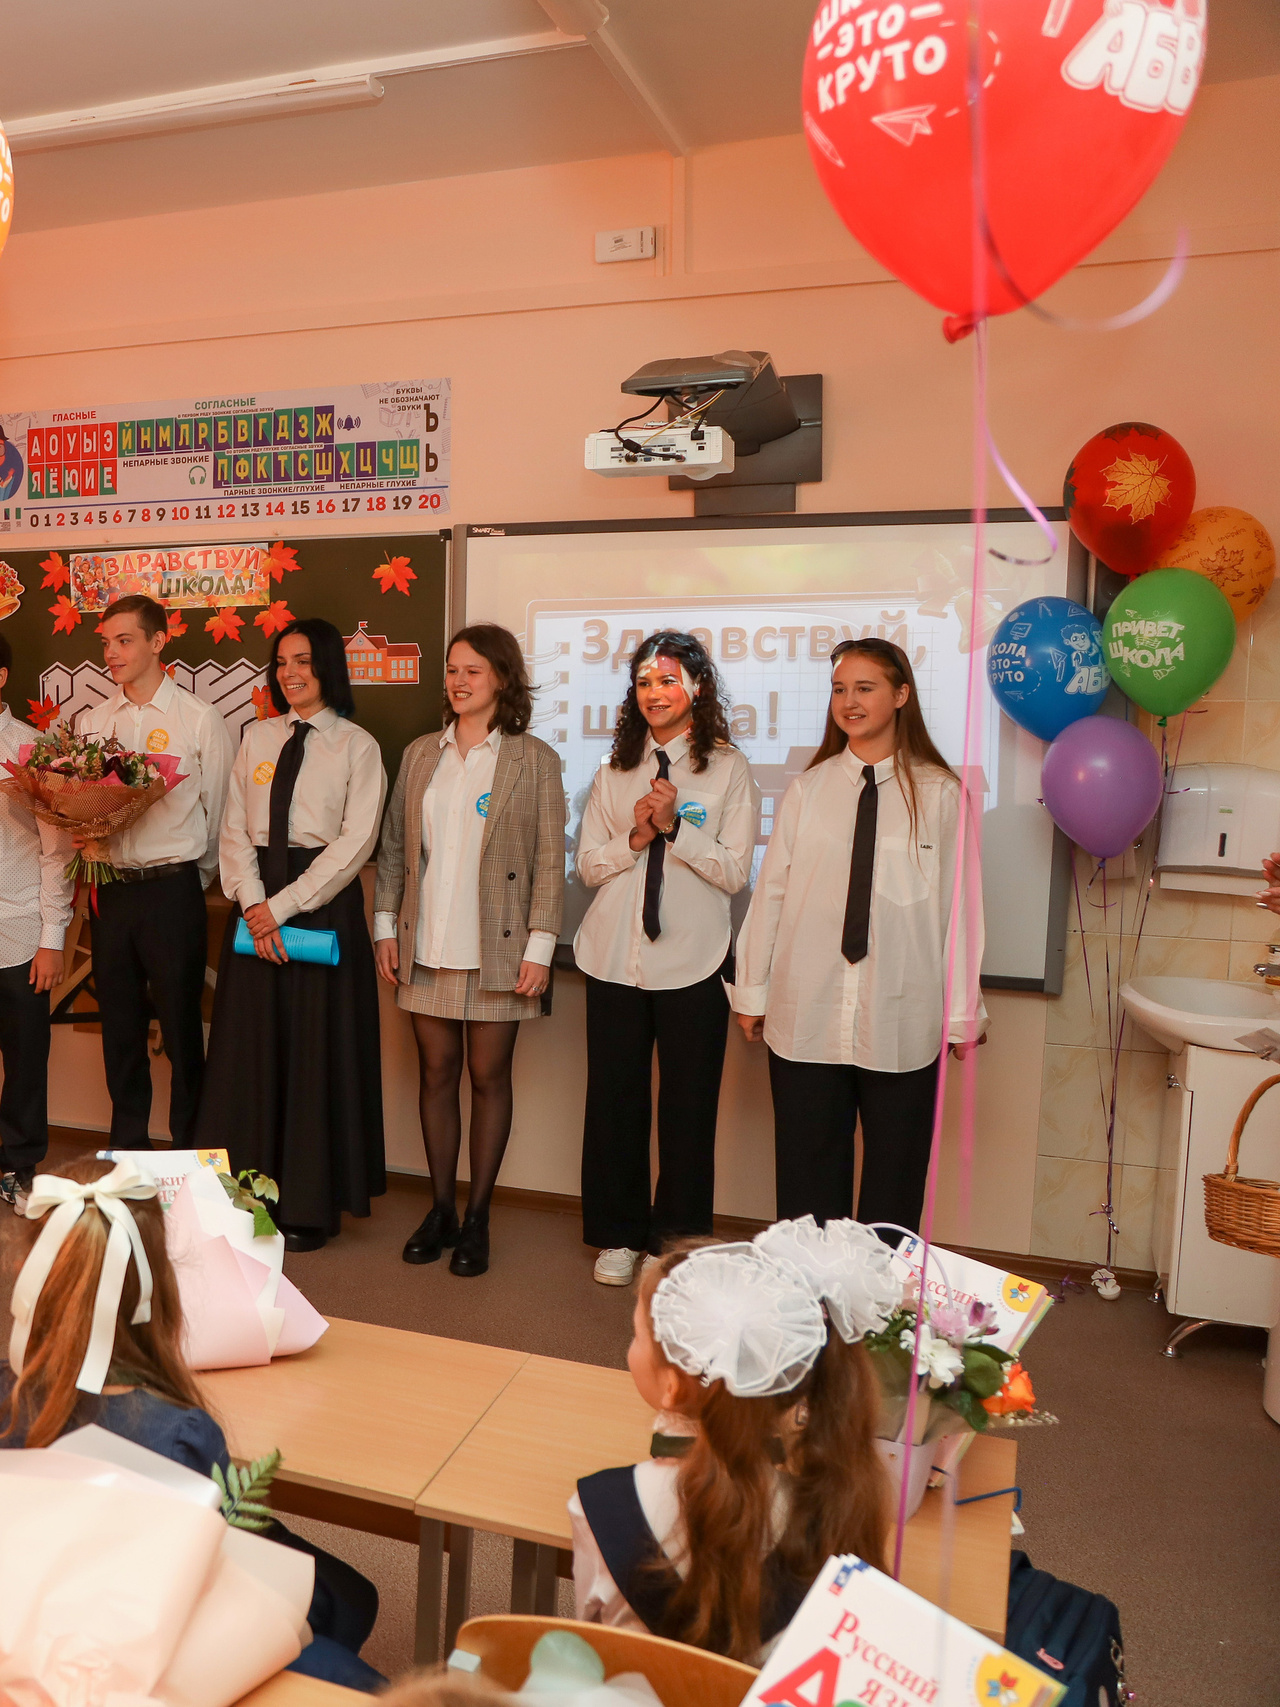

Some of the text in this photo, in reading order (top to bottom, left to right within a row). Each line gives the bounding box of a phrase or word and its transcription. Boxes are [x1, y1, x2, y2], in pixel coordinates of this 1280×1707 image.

[1061, 3, 1207, 116] АБВ
[817, 35, 947, 114] КРУТО
[194, 398, 256, 410] СОГЛАСНЫЕ
[390, 394, 440, 403] ОБОЗНАЧАЮТ
[396, 387, 423, 395] БУКВЫ
[52, 410, 97, 423] ГЛАСНЫЕ
[397, 404, 421, 412] ЗВУКИ
[423, 403, 439, 432] Ъ
[31, 413, 332, 457] А О У Ы Э Й Н М Л Р Б В Г Д З Ж
[123, 455, 210, 468] НЕПАРНЫЕ ЗВОНКИЕ
[217, 445, 418, 481] П Ф К Т С Ш Х Ц Ч Щ
[425, 443, 438, 473] Ь
[31, 466, 113, 494] Я Ё Ю И Е
[223, 484, 325, 497] ПАРНЫЕ ЗВОНКИЕ/ГЛУХИЕ
[339, 479, 417, 490] НЕПАРНЫЕ ГЛУХИЕ
[30, 514, 39, 528] 0
[44, 514, 51, 527] 1
[56, 513, 65, 526] 2
[70, 512, 79, 525] 3
[84, 511, 94, 525] 4
[98, 511, 107, 524] 5
[113, 510, 122, 524] 6
[128, 509, 137, 522] 7
[141, 508, 151, 522] 8
[156, 508, 166, 522] 9
[172, 507, 189, 521] 10
[195, 505, 211, 519] 11
[217, 504, 236, 518] 12
[241, 503, 260, 517] 13
[266, 502, 285, 516] 14
[291, 500, 310, 514] 15
[316, 499, 336, 513] 16
[342, 498, 360, 512] 17
[366, 496, 386, 511] 18
[393, 495, 412, 510] 19
[418, 494, 441, 509] 20
[158, 573, 255, 599] ШКОЛА!
[1112, 620, 1186, 643] ПРИВЕТ,
[1109, 640, 1186, 668] ШКОЛА
[828, 1608, 941, 1704] Русский
